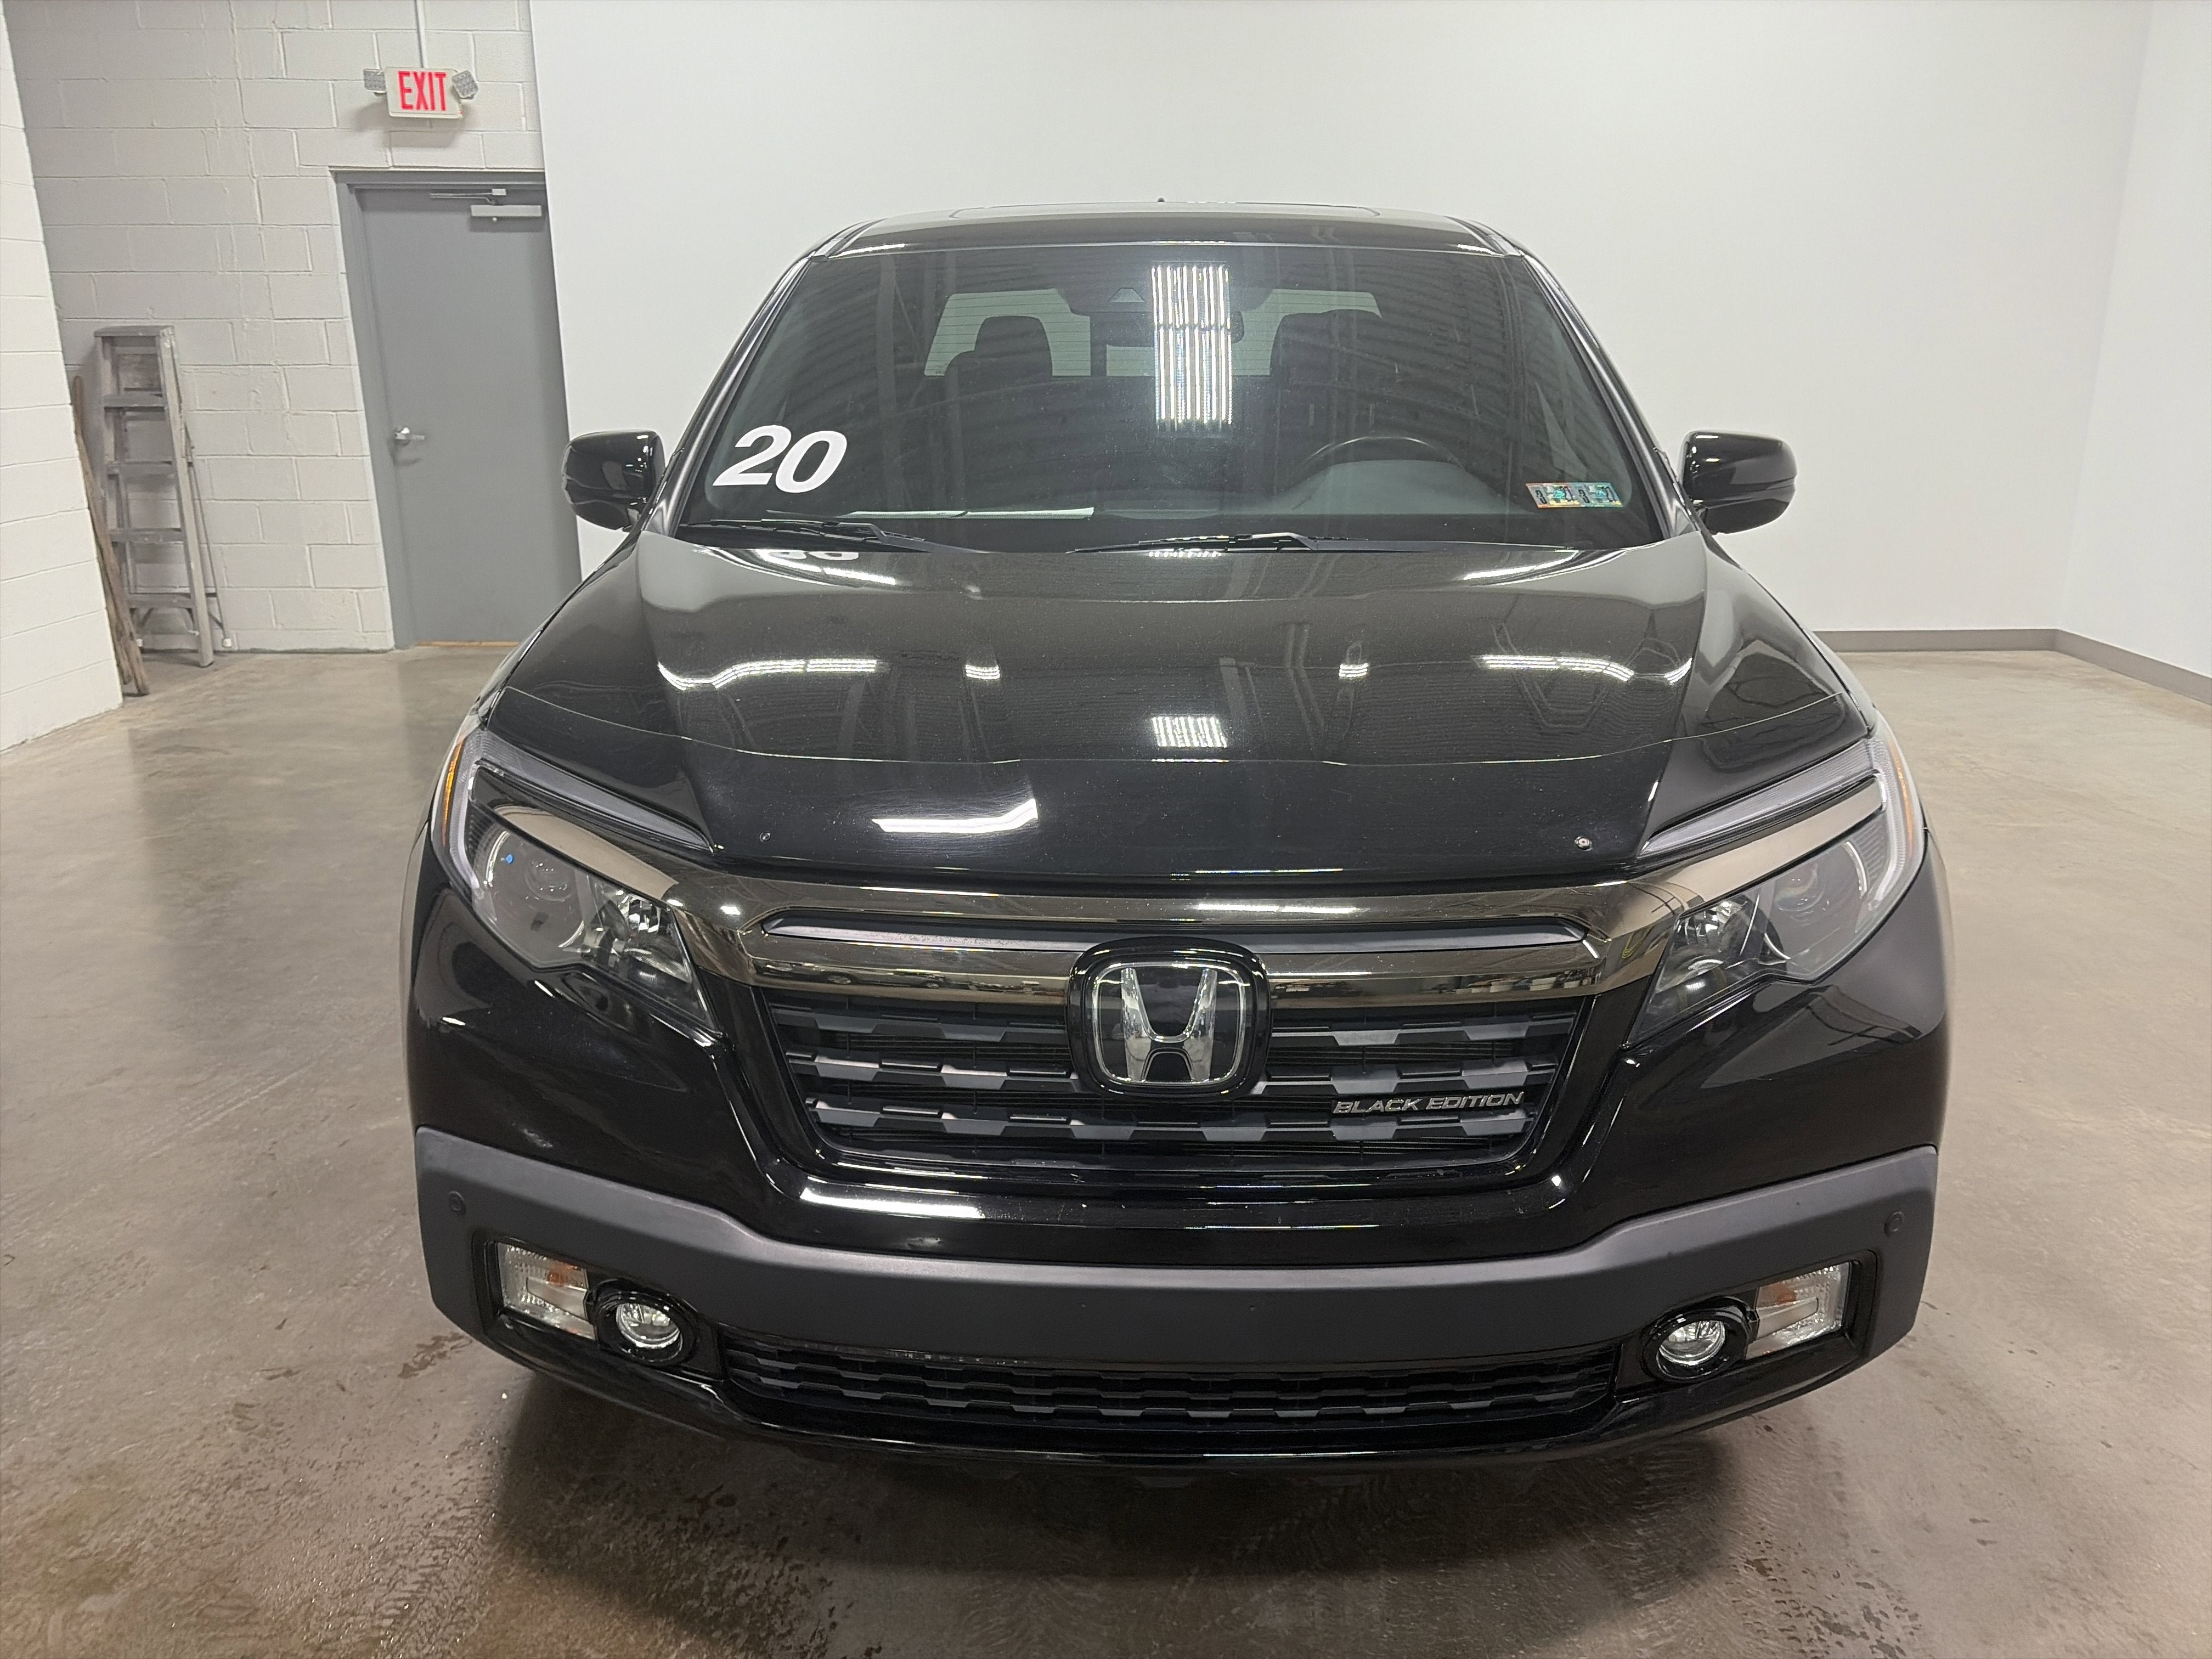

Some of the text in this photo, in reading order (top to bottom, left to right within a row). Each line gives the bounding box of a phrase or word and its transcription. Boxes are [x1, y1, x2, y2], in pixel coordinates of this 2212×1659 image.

[397, 70, 447, 111] EXIT
[713, 425, 847, 493] 20
[1333, 1092, 1525, 1114] BLACK EDITION
